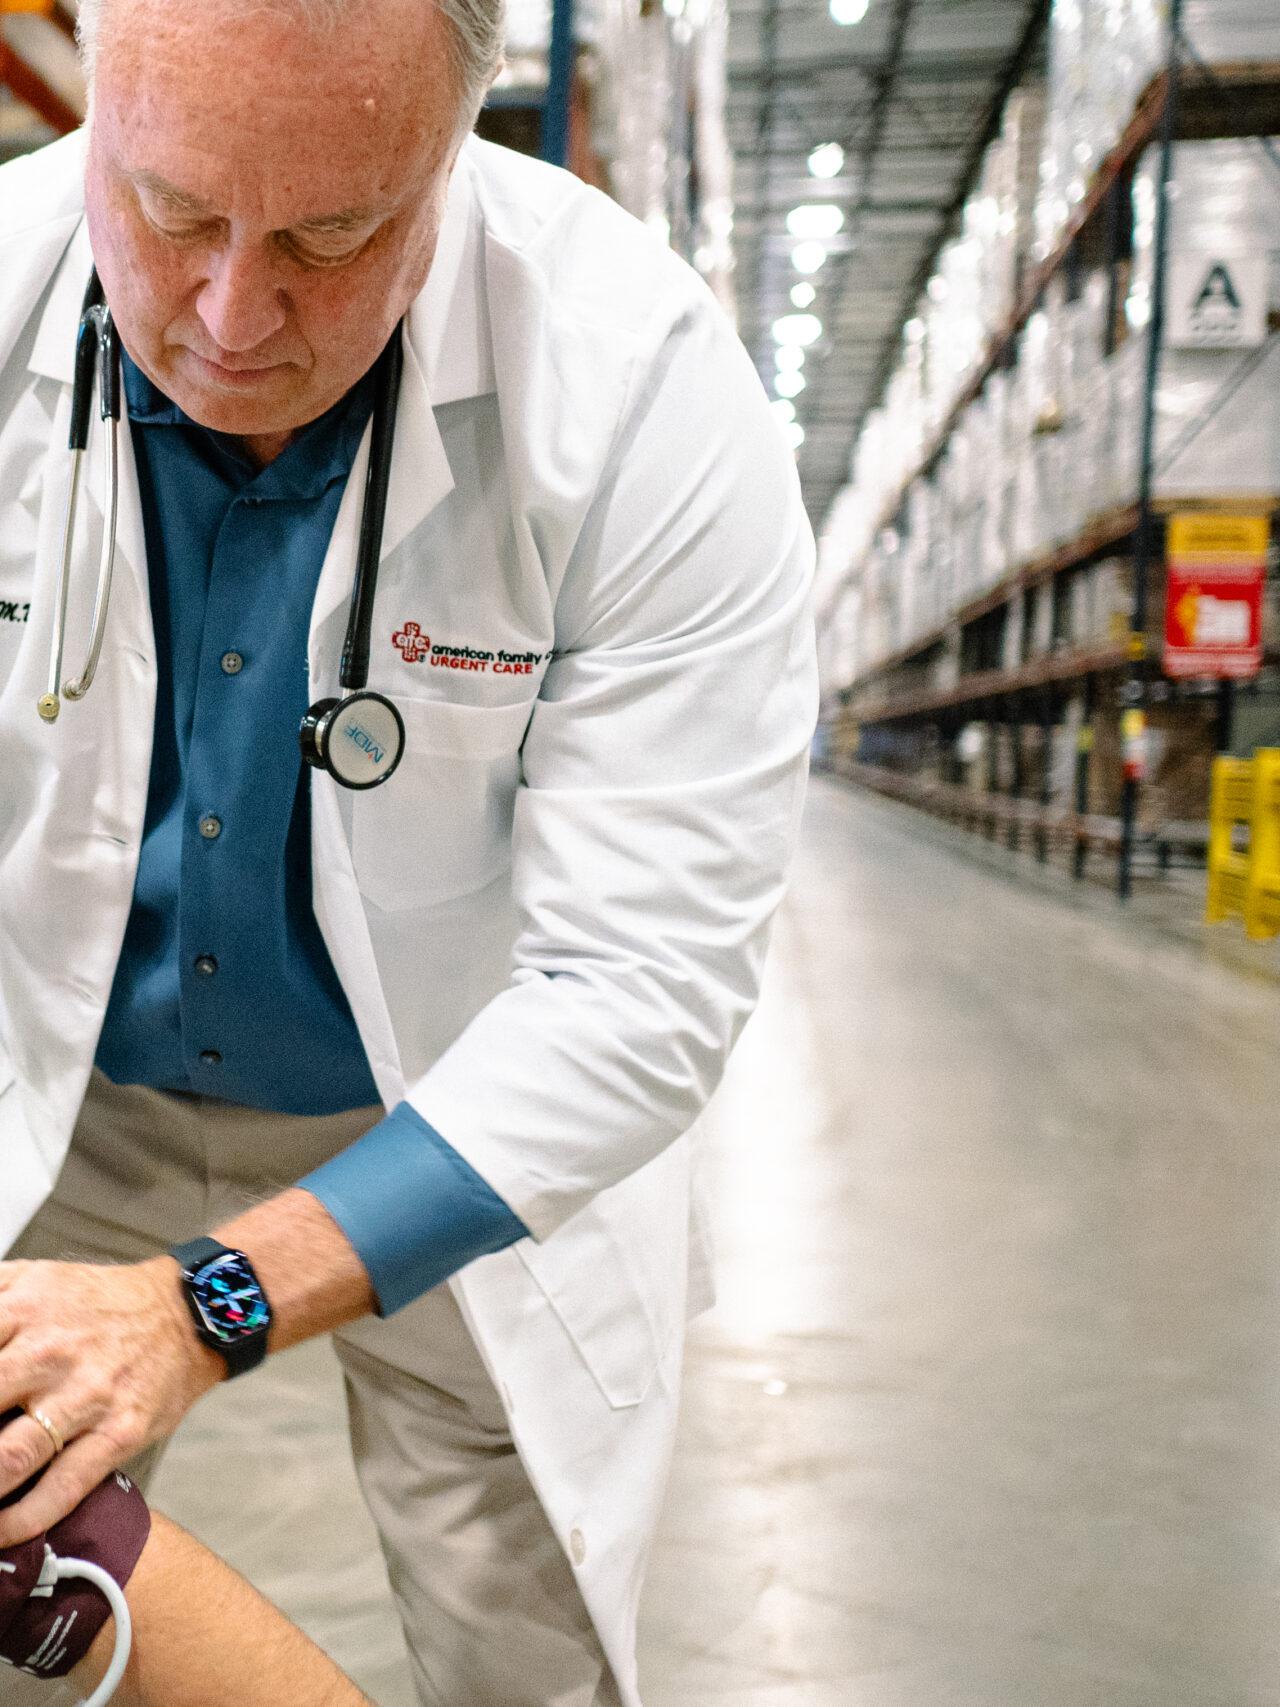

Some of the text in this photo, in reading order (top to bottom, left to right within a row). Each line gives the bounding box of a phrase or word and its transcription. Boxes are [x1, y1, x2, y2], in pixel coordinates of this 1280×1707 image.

[1192, 263, 1241, 309] A
[431, 643, 494, 662] american
[497, 650, 542, 665] family
[430, 656, 533, 675] URGENT CARE
